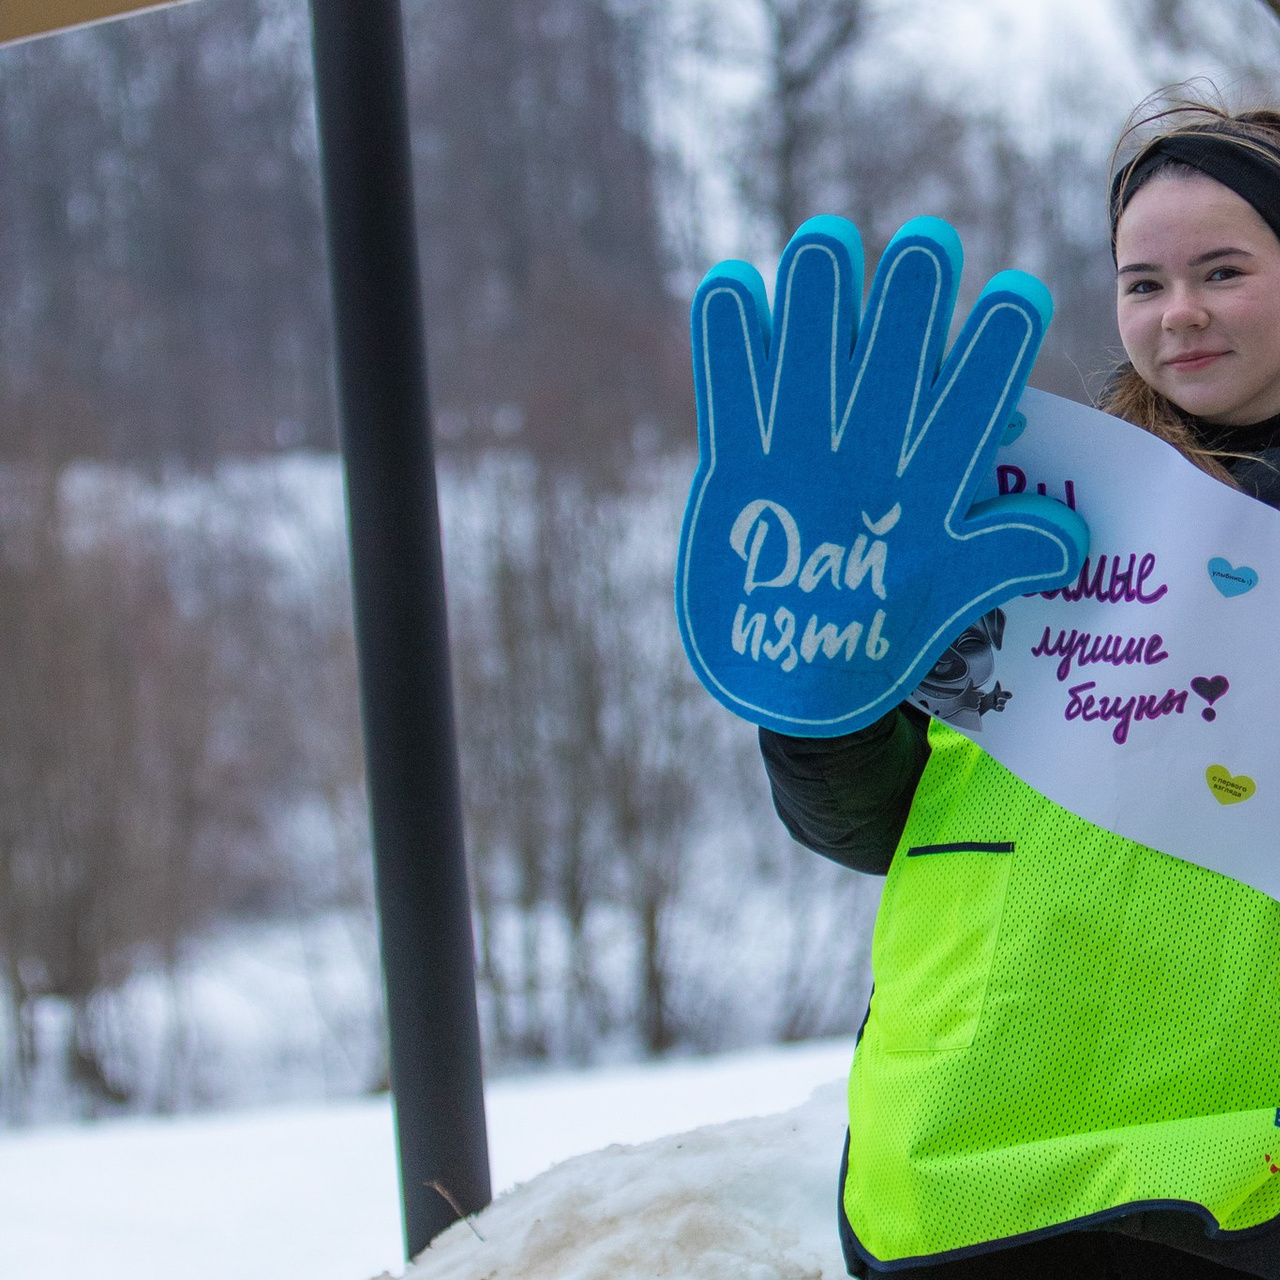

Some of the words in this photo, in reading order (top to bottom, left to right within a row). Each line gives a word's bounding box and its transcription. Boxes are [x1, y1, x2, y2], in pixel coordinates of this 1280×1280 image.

[729, 499, 902, 601] Дай
[1020, 552, 1169, 605] мые
[731, 603, 890, 673] пять
[1030, 625, 1169, 682] лучшие
[1213, 783, 1242, 798] взгляда
[1217, 778, 1248, 793] первого
